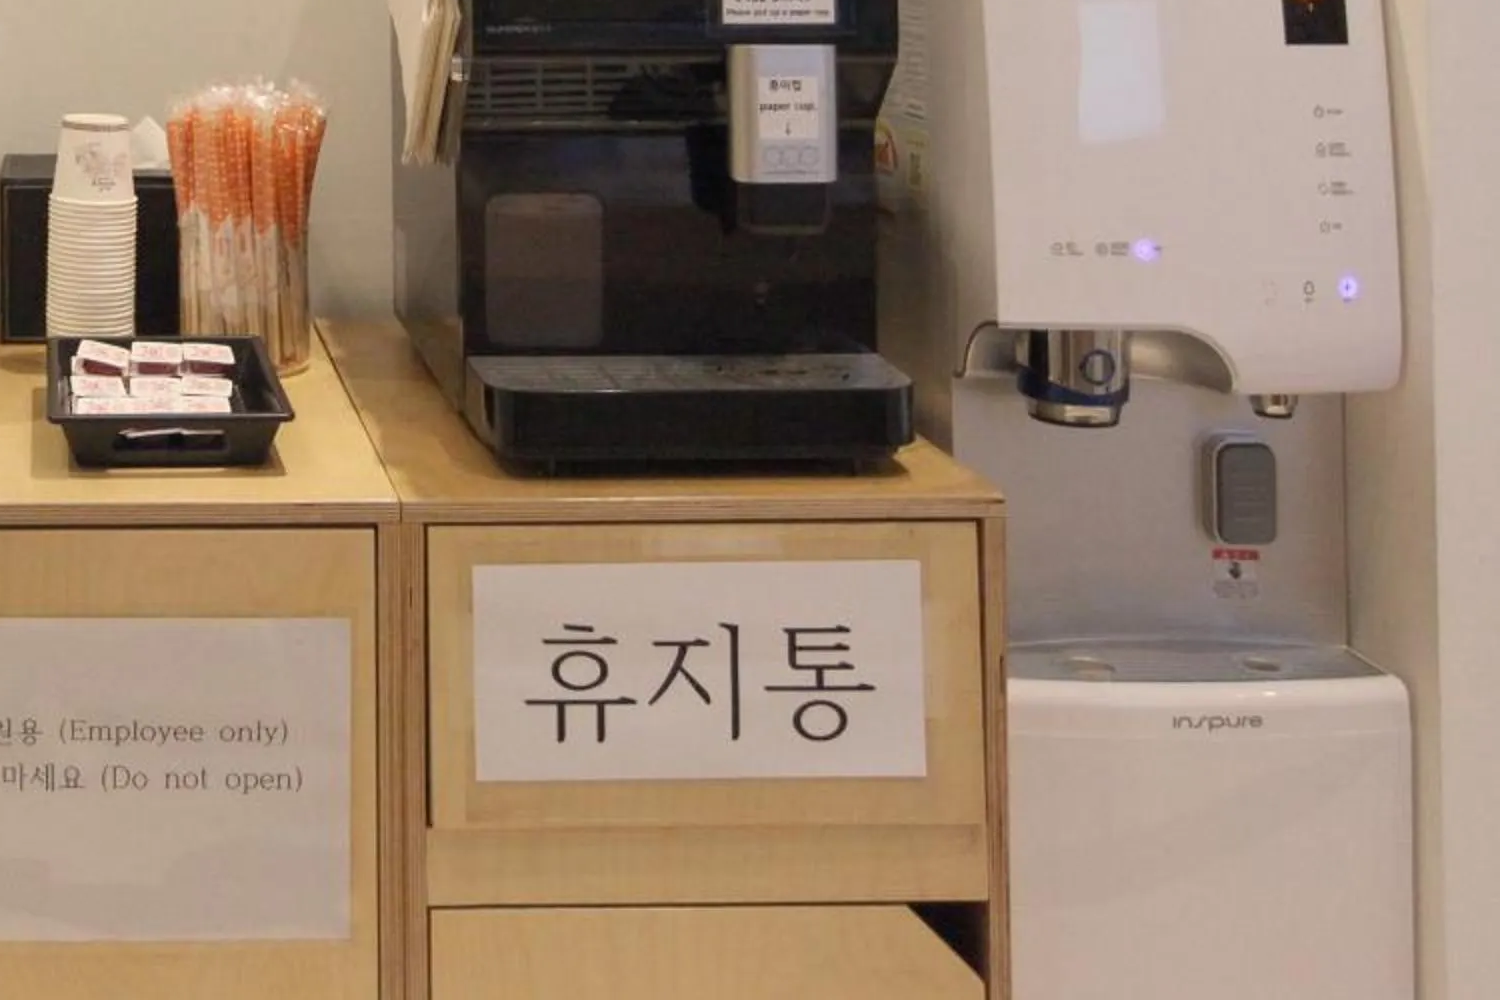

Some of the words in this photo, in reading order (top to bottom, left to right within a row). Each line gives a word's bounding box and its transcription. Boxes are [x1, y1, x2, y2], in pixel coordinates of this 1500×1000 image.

[768, 79, 802, 92] 종이컵
[758, 102, 791, 113] paper
[523, 621, 877, 745] 휴지통
[58, 718, 206, 748] (Employee
[218, 718, 289, 746] only)
[100, 762, 150, 793] (Do
[164, 766, 208, 791] not
[224, 766, 304, 796] open)
